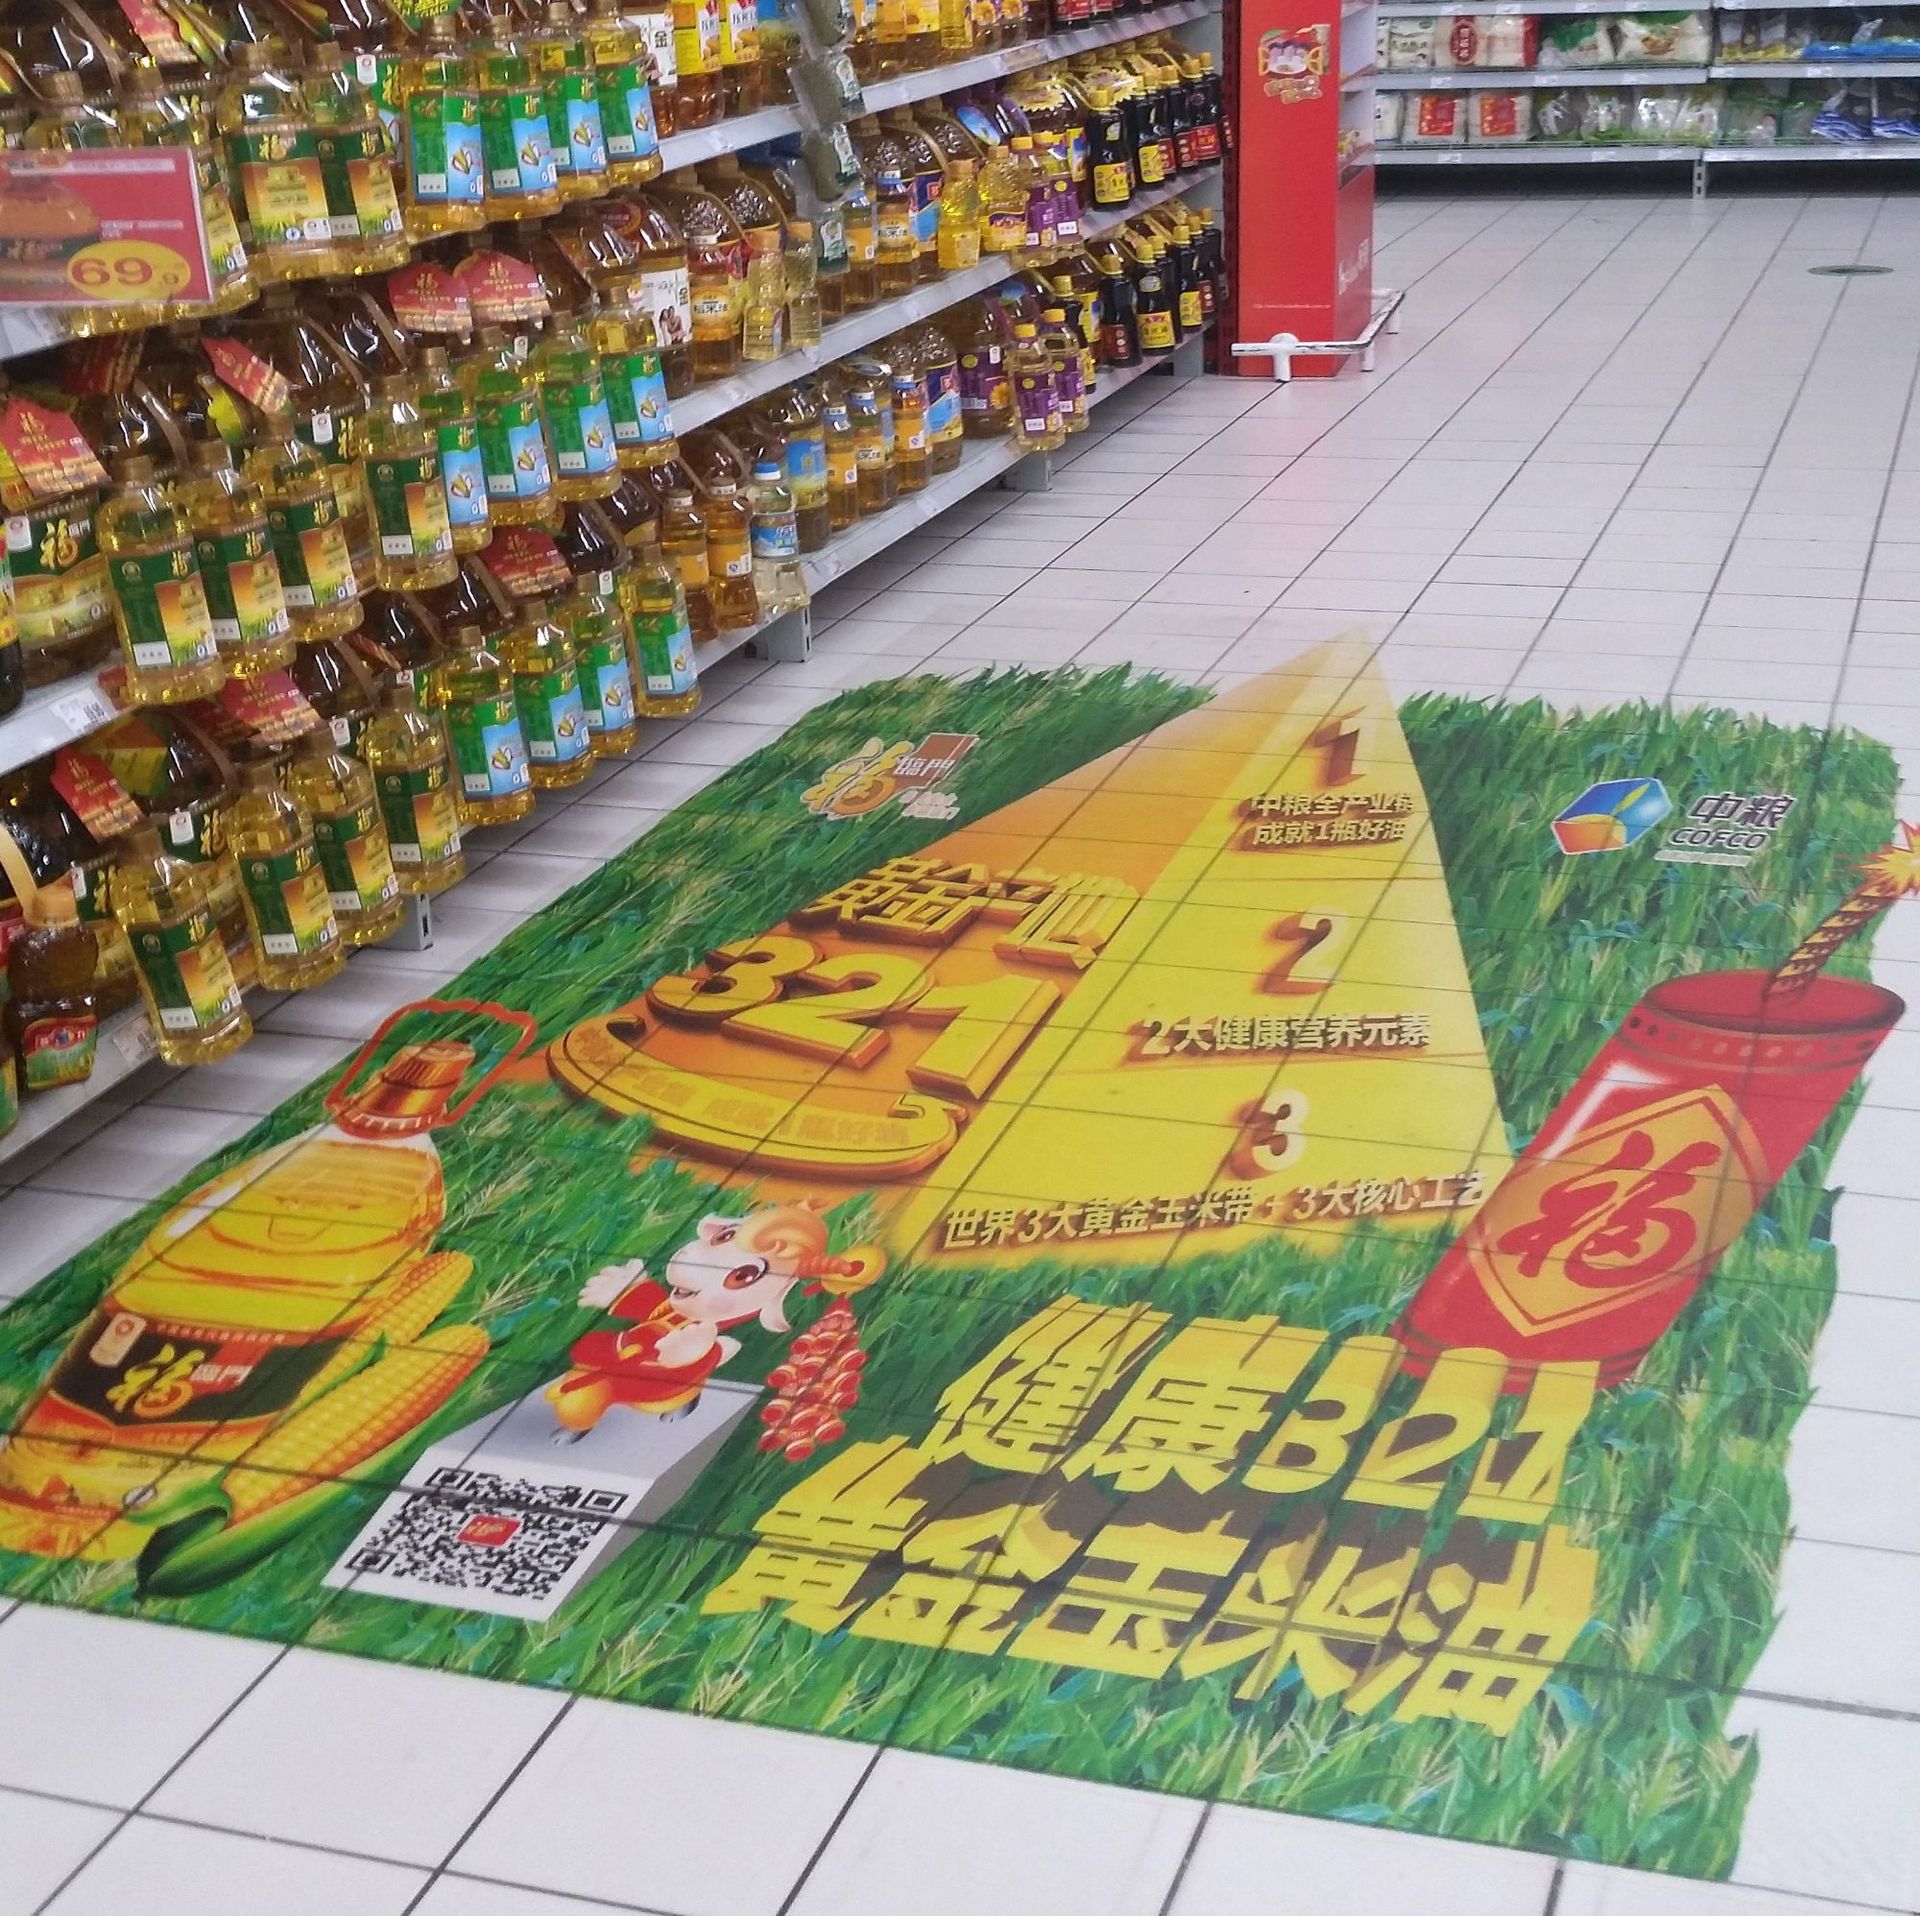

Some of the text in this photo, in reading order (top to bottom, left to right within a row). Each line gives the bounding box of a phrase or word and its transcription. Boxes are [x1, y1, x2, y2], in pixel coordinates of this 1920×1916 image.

[1253, 819, 1407, 846] 成就1瓶好油
[1668, 827, 1770, 851] COFCO
[1264, 908, 1348, 995] 2
[647, 935, 1063, 1100] 321
[1132, 1013, 1432, 1056] 2大健康营养元素
[1235, 1088, 1309, 1178] 3
[699, 1433, 1600, 1737] 黄金玉米油
